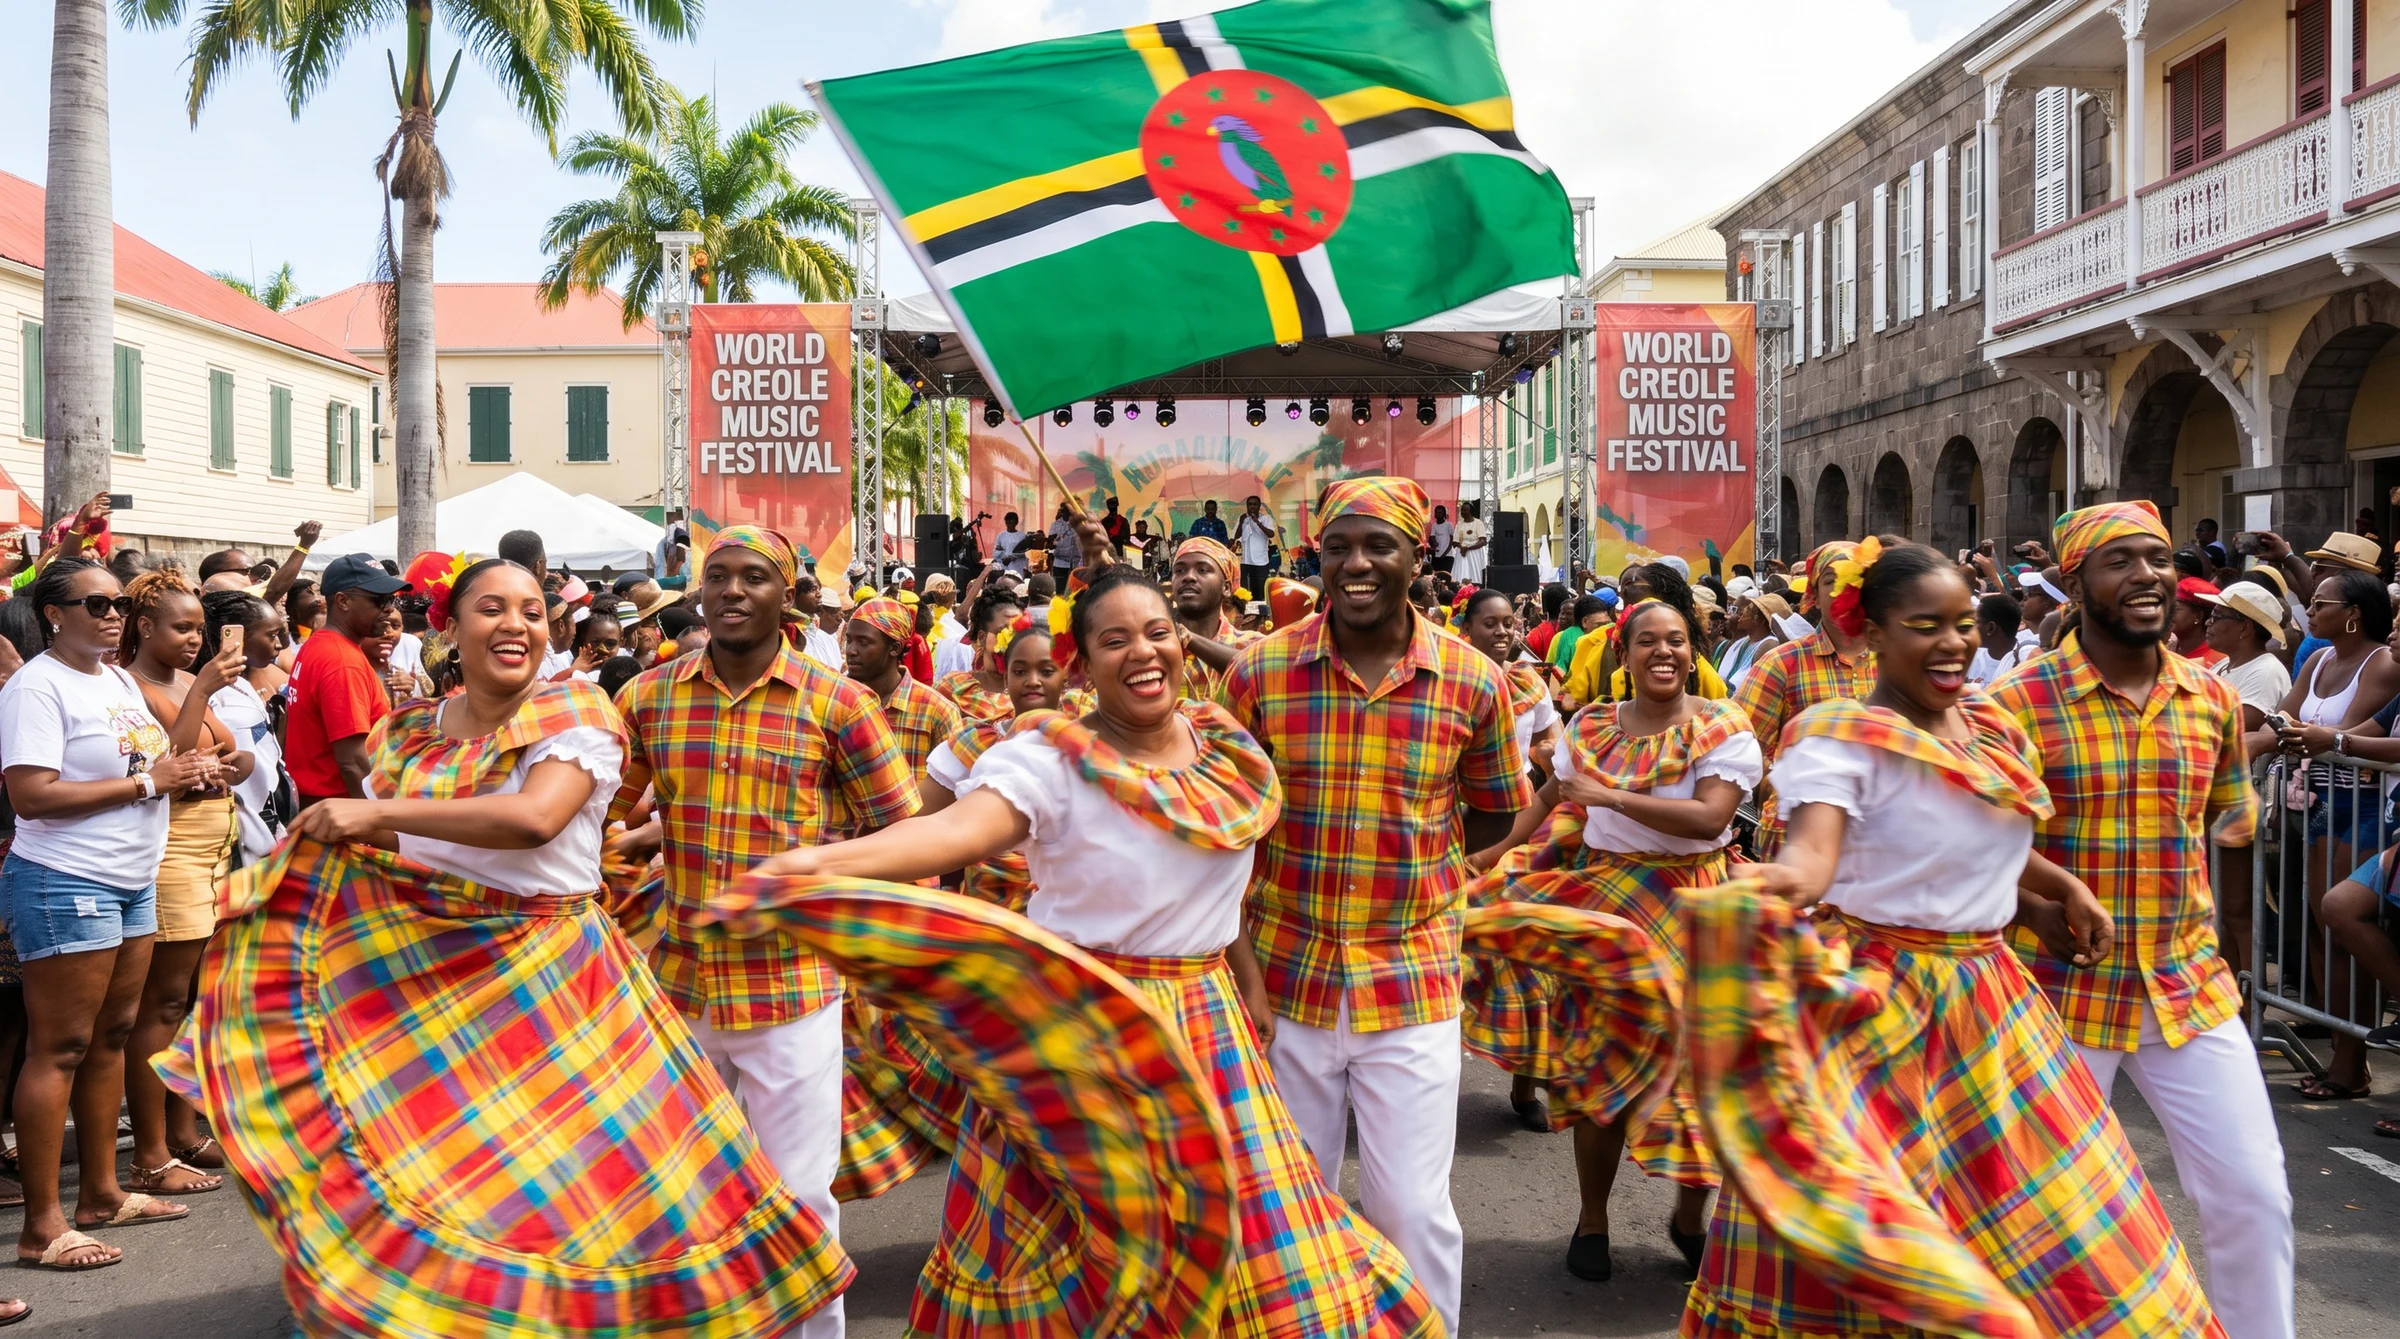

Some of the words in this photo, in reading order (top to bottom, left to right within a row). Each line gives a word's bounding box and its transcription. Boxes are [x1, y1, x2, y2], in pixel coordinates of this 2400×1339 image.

[715, 333, 825, 365] WORLD
[1622, 332, 1731, 364] WORLD
[711, 368, 829, 401] CREOLE
[1619, 367, 1735, 400] CREOLE
[721, 405, 820, 438] MUSIC
[1629, 403, 1726, 436] MUSIC
[700, 442, 842, 474] FESTIVAL
[1607, 439, 1746, 472] FESTIVAL
